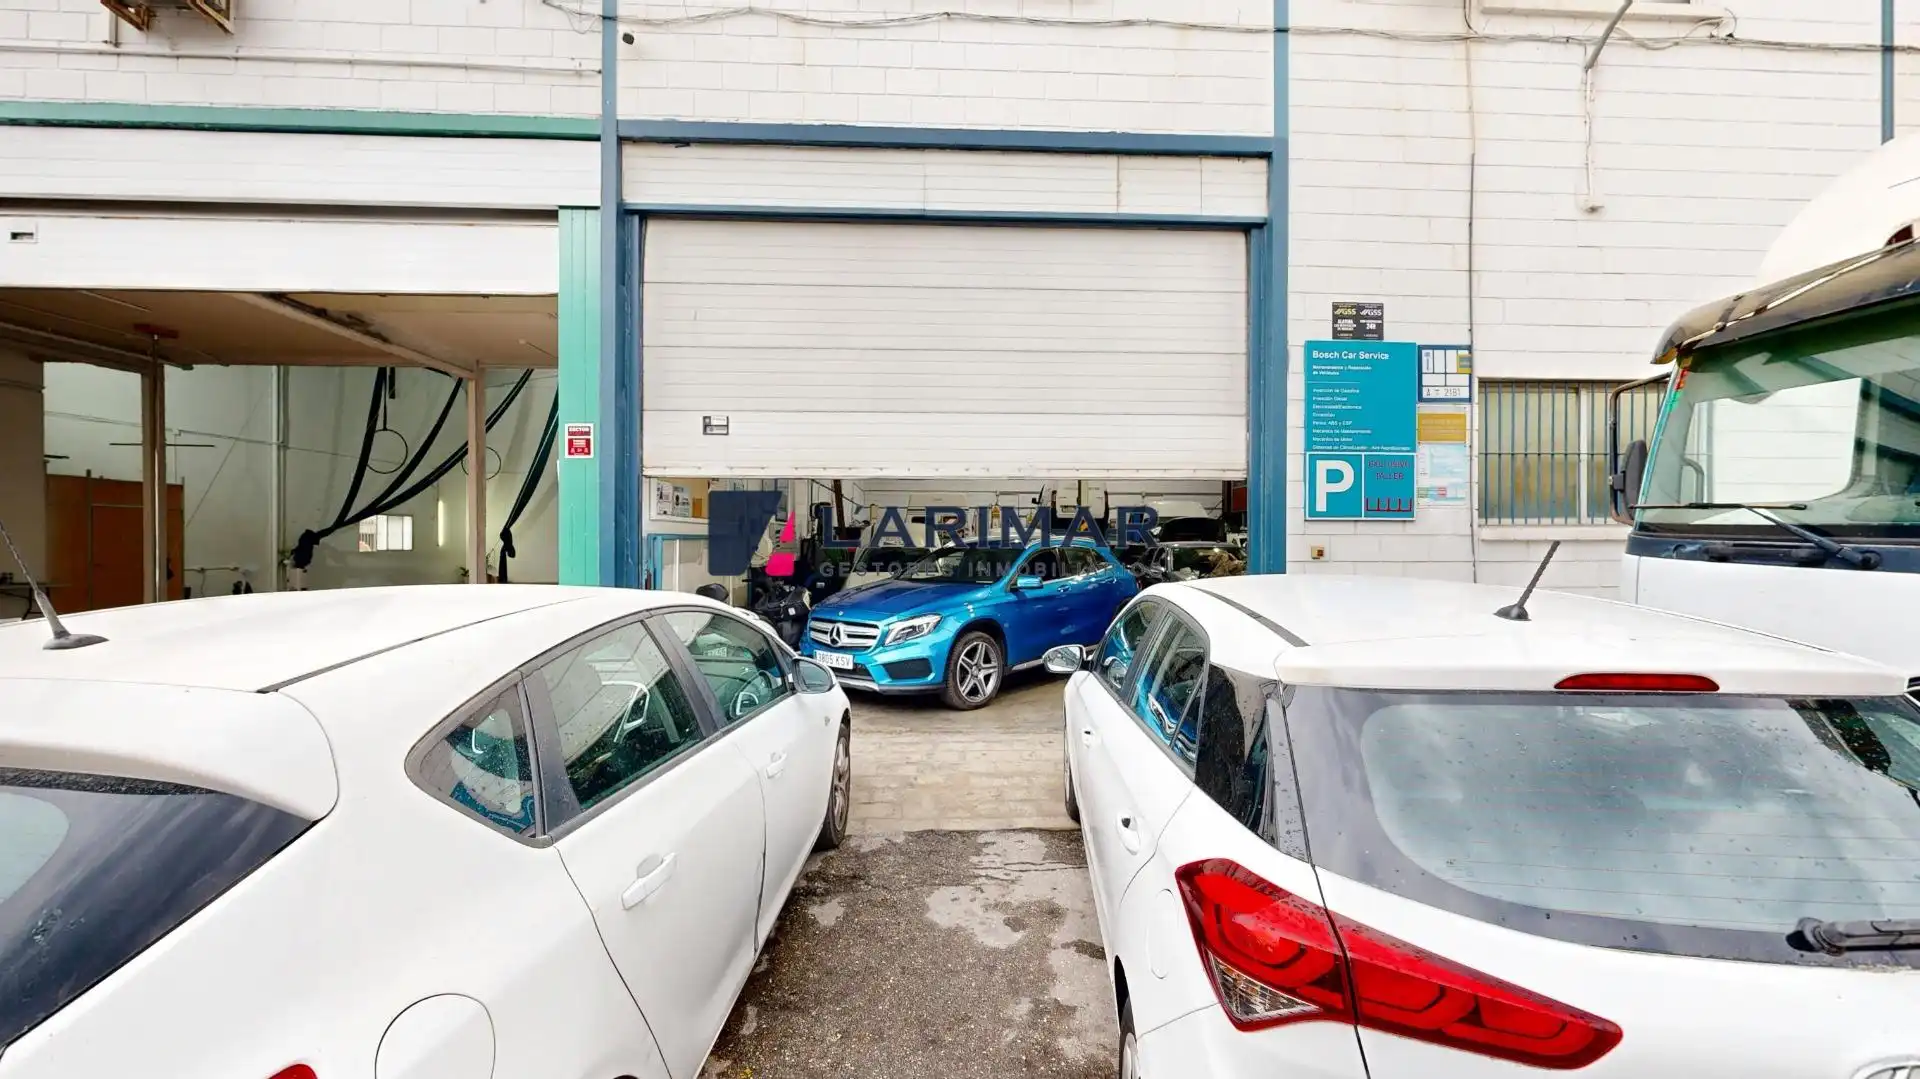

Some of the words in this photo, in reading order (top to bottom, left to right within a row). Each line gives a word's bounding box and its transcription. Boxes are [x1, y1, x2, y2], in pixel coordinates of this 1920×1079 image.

[1312, 350, 1340, 359] Bosch
[1341, 351, 1357, 359] Car
[1359, 351, 1390, 360] Service
[1315, 459, 1355, 512] P
[835, 655, 851, 667] KSV
